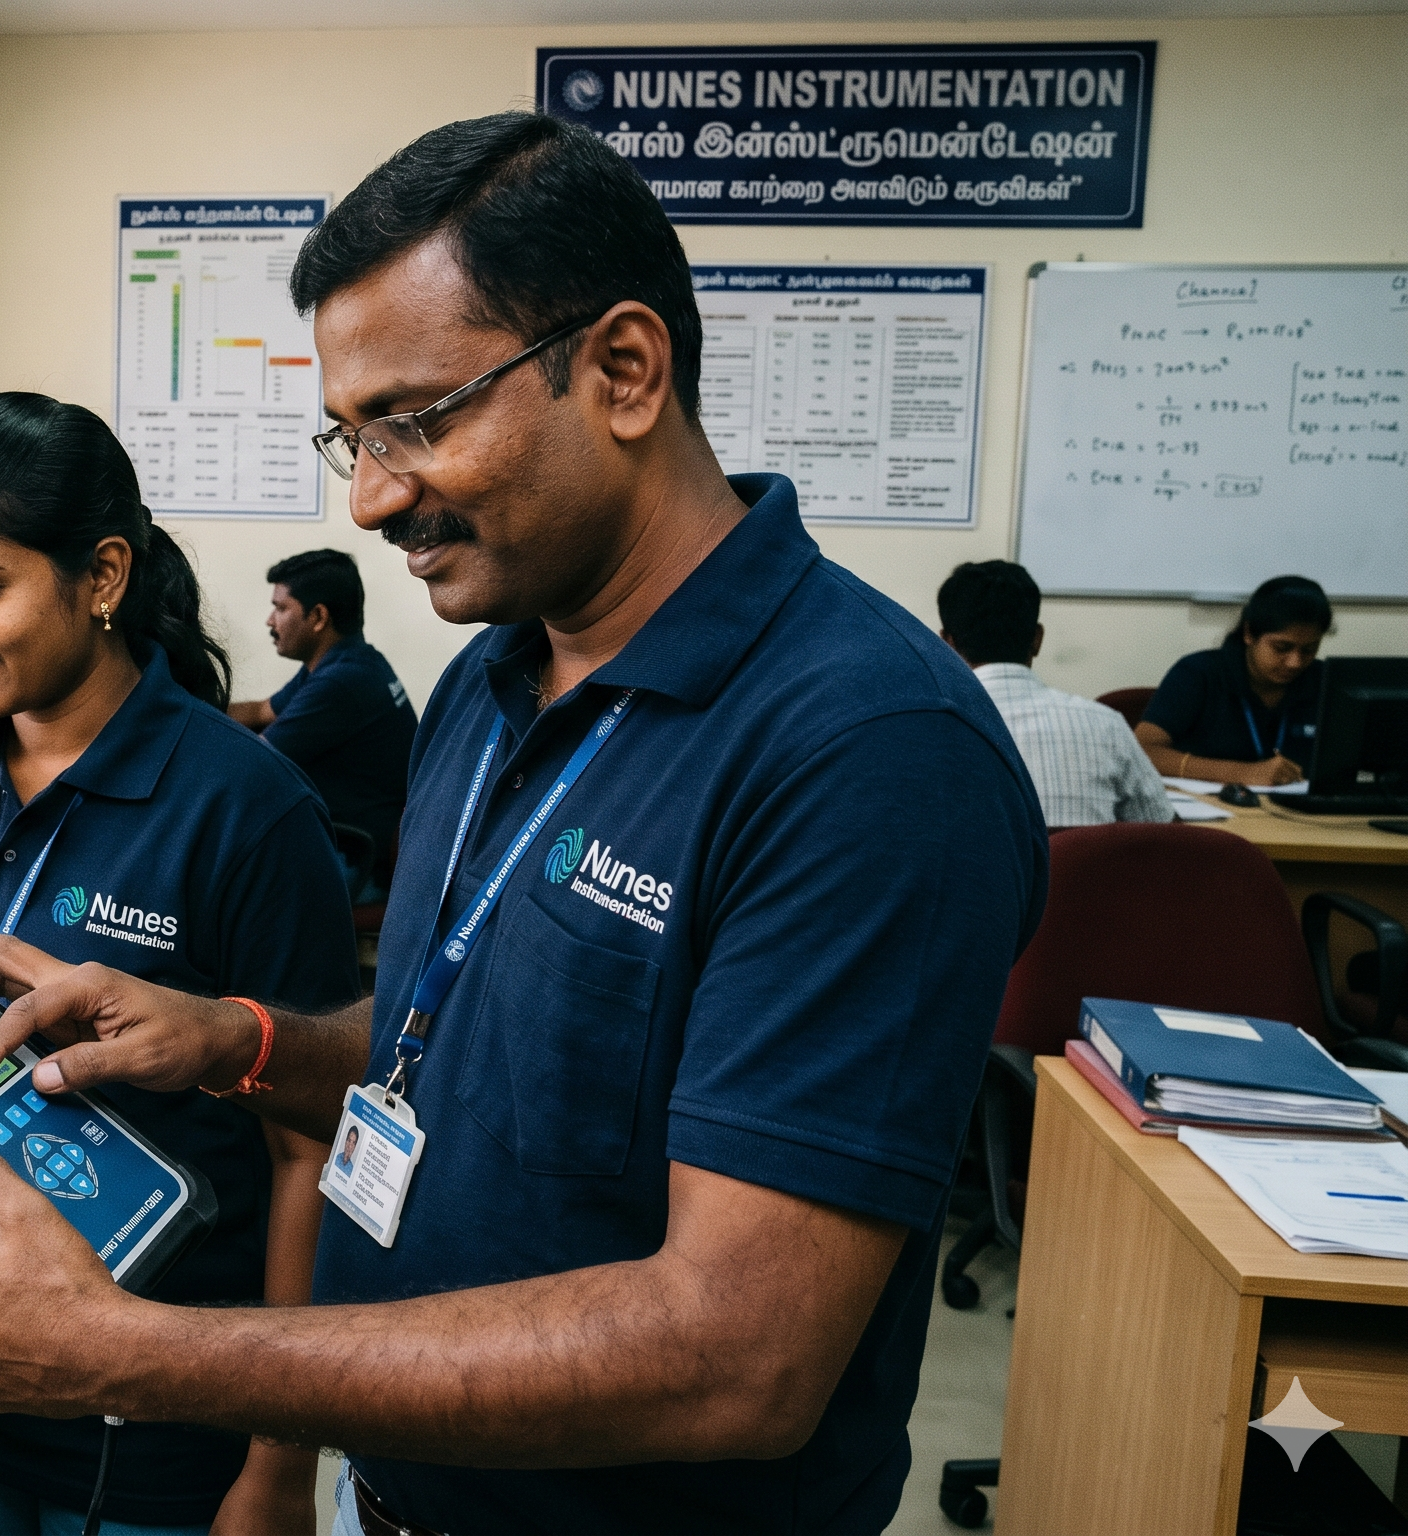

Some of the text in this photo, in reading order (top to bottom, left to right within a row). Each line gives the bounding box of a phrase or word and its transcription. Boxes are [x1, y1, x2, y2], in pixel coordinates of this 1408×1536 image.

[612, 68, 1126, 109] NUNES INSTRUMENTATION
[593, 120, 685, 159] ன்ஸ்
[643, 179, 725, 200] ரமான
[728, 173, 826, 206] காற்றை
[830, 173, 949, 207] அளவிடும்
[578, 839, 673, 912] Nunes
[88, 892, 179, 937] Nunes
[570, 875, 666, 935] Instrumentation
[85, 919, 176, 952] Instrumentation
